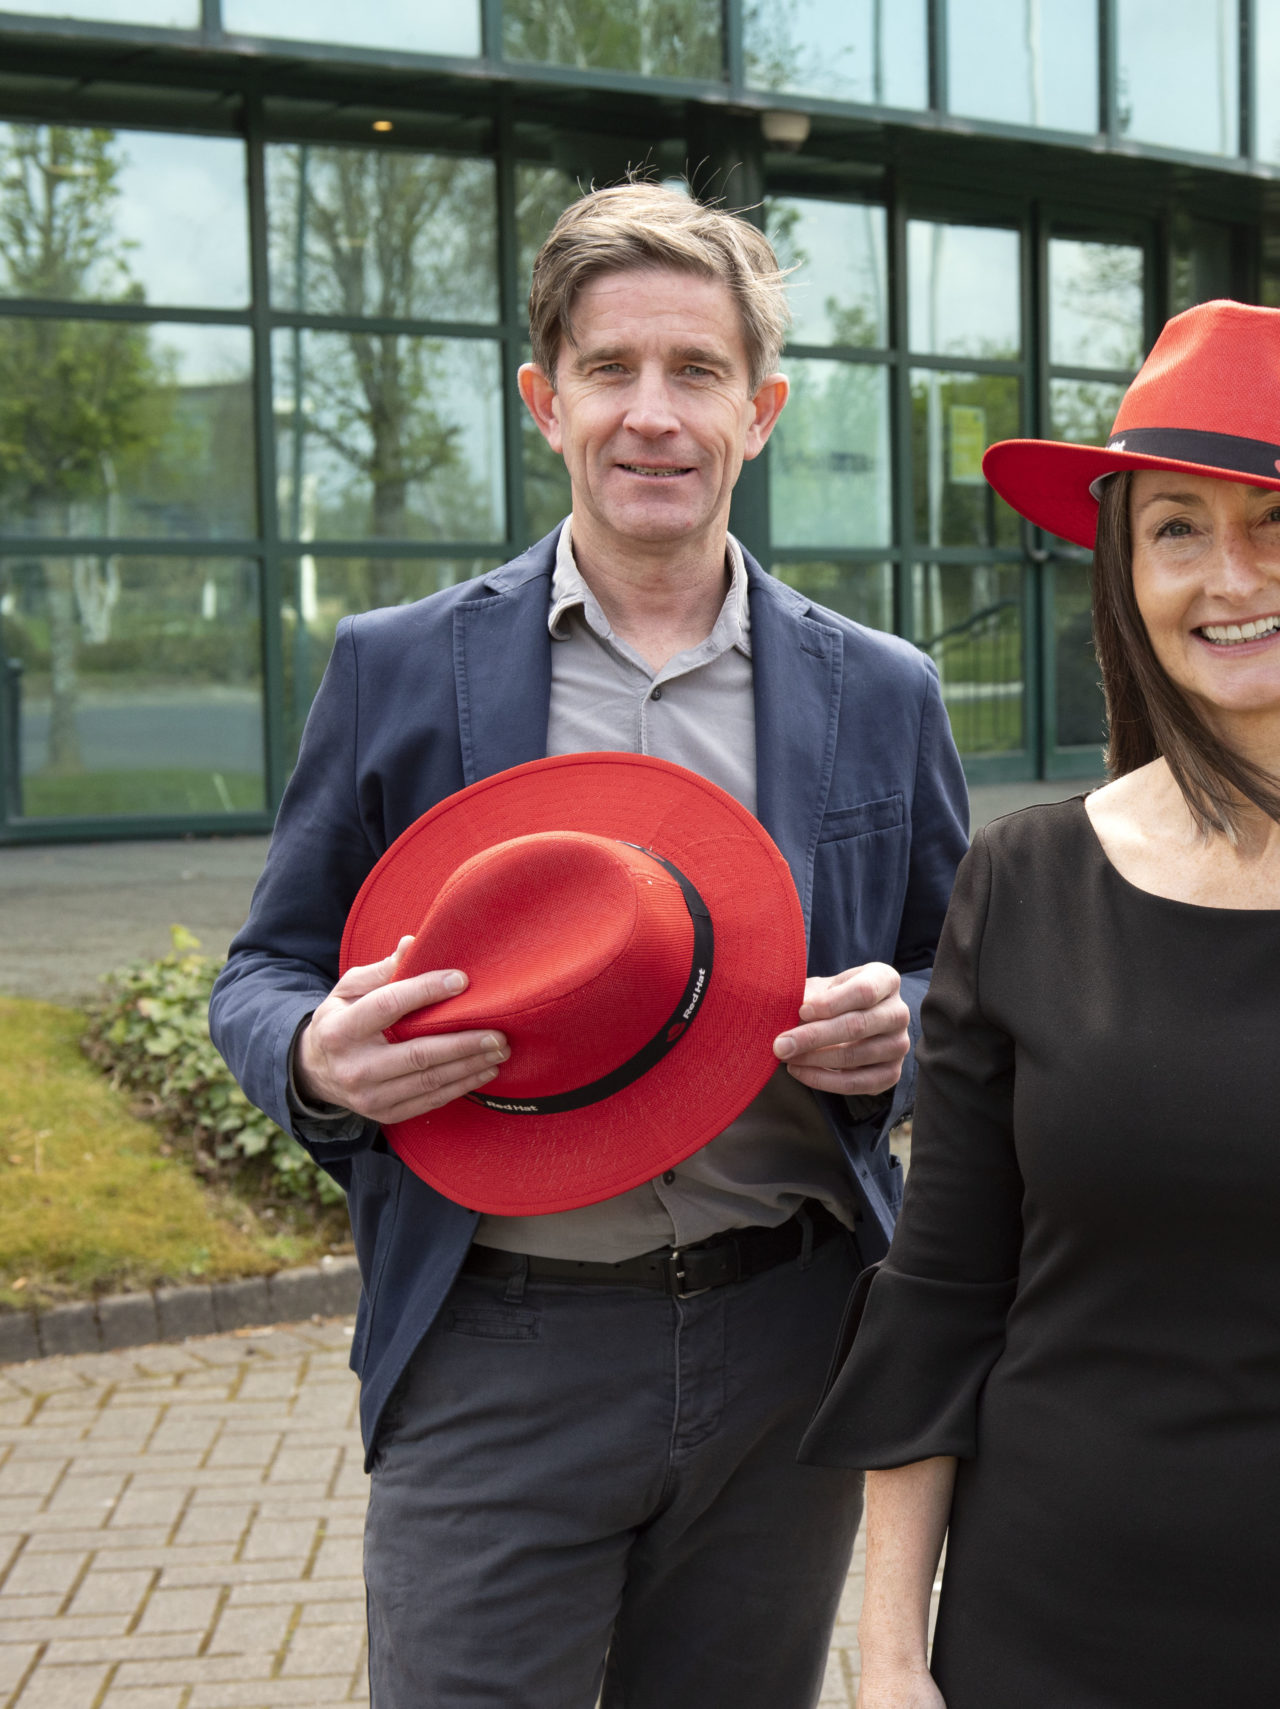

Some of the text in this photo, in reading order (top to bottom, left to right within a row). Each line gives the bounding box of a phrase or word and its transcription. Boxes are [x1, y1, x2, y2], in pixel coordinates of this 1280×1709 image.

[682, 968, 706, 1020] Red Hat
[486, 1100, 513, 1111] Red
